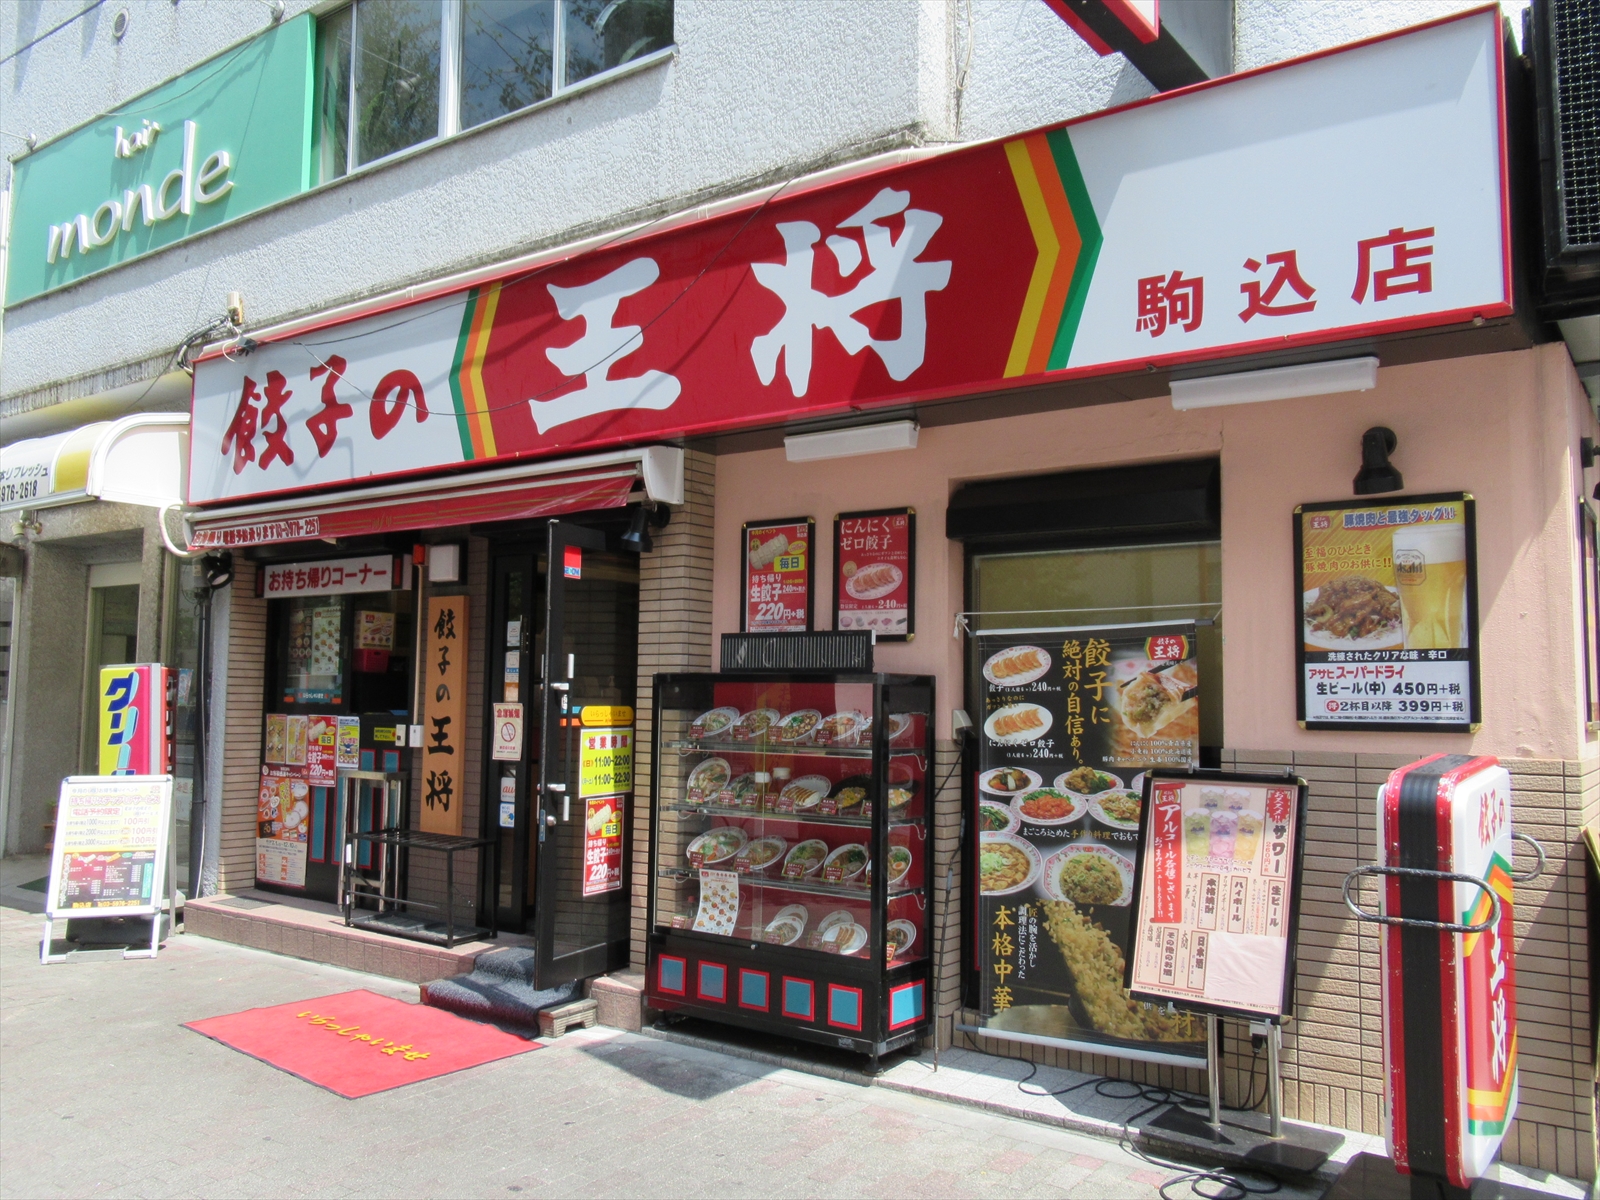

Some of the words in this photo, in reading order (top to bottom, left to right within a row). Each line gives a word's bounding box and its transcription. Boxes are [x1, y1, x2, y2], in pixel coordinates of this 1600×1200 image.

[114, 118, 161, 159] hair
[47, 119, 234, 264] monde
[1135, 226, 1436, 338] 駒込店
[840, 517, 891, 535] にんにく
[1343, 506, 1456, 529] 豚焼肉と最強タッグ!!
[839, 534, 893, 551] ゼロ餃子
[1304, 543, 1371, 559] 至福のひととき
[779, 556, 800, 569] 毎日
[1305, 557, 1392, 572] 豚焼肉のお供に!!
[1396, 561, 1423, 574] Asahi
[268, 563, 387, 592] お持ち帰りコーナー
[751, 573, 782, 584] 持ち帰り
[750, 583, 782, 602] 生餃子
[755, 602, 805, 621] 220円+税
[1153, 645, 1181, 659] 王将
[1328, 650, 1447, 661] 洗練されたクリアな味・辛口
[1083, 638, 1113, 725] 餃子に
[1308, 665, 1404, 680] アサヒスーパードライ
[1316, 681, 1386, 696] 生ビール(中)
[1393, 682, 1461, 695] 450円+税
[426, 608, 457, 813] 餃子の王将
[1062, 640, 1085, 764] 絶対の自信あり。
[1398, 700, 1464, 712] 399円+税
[104, 671, 140, 775] クリー
[588, 735, 628, 750] 営業時間
[1271, 824, 1287, 874] サワー
[1231, 881, 1244, 922] ハイボール
[1269, 885, 1282, 928] 生ビール
[991, 905, 1016, 1013] 本格中華
[1162, 931, 1175, 977] その他のお酒
[1195, 936, 1206, 969] 日本酒
[296, 1010, 431, 1062] いらっしゃいませ
